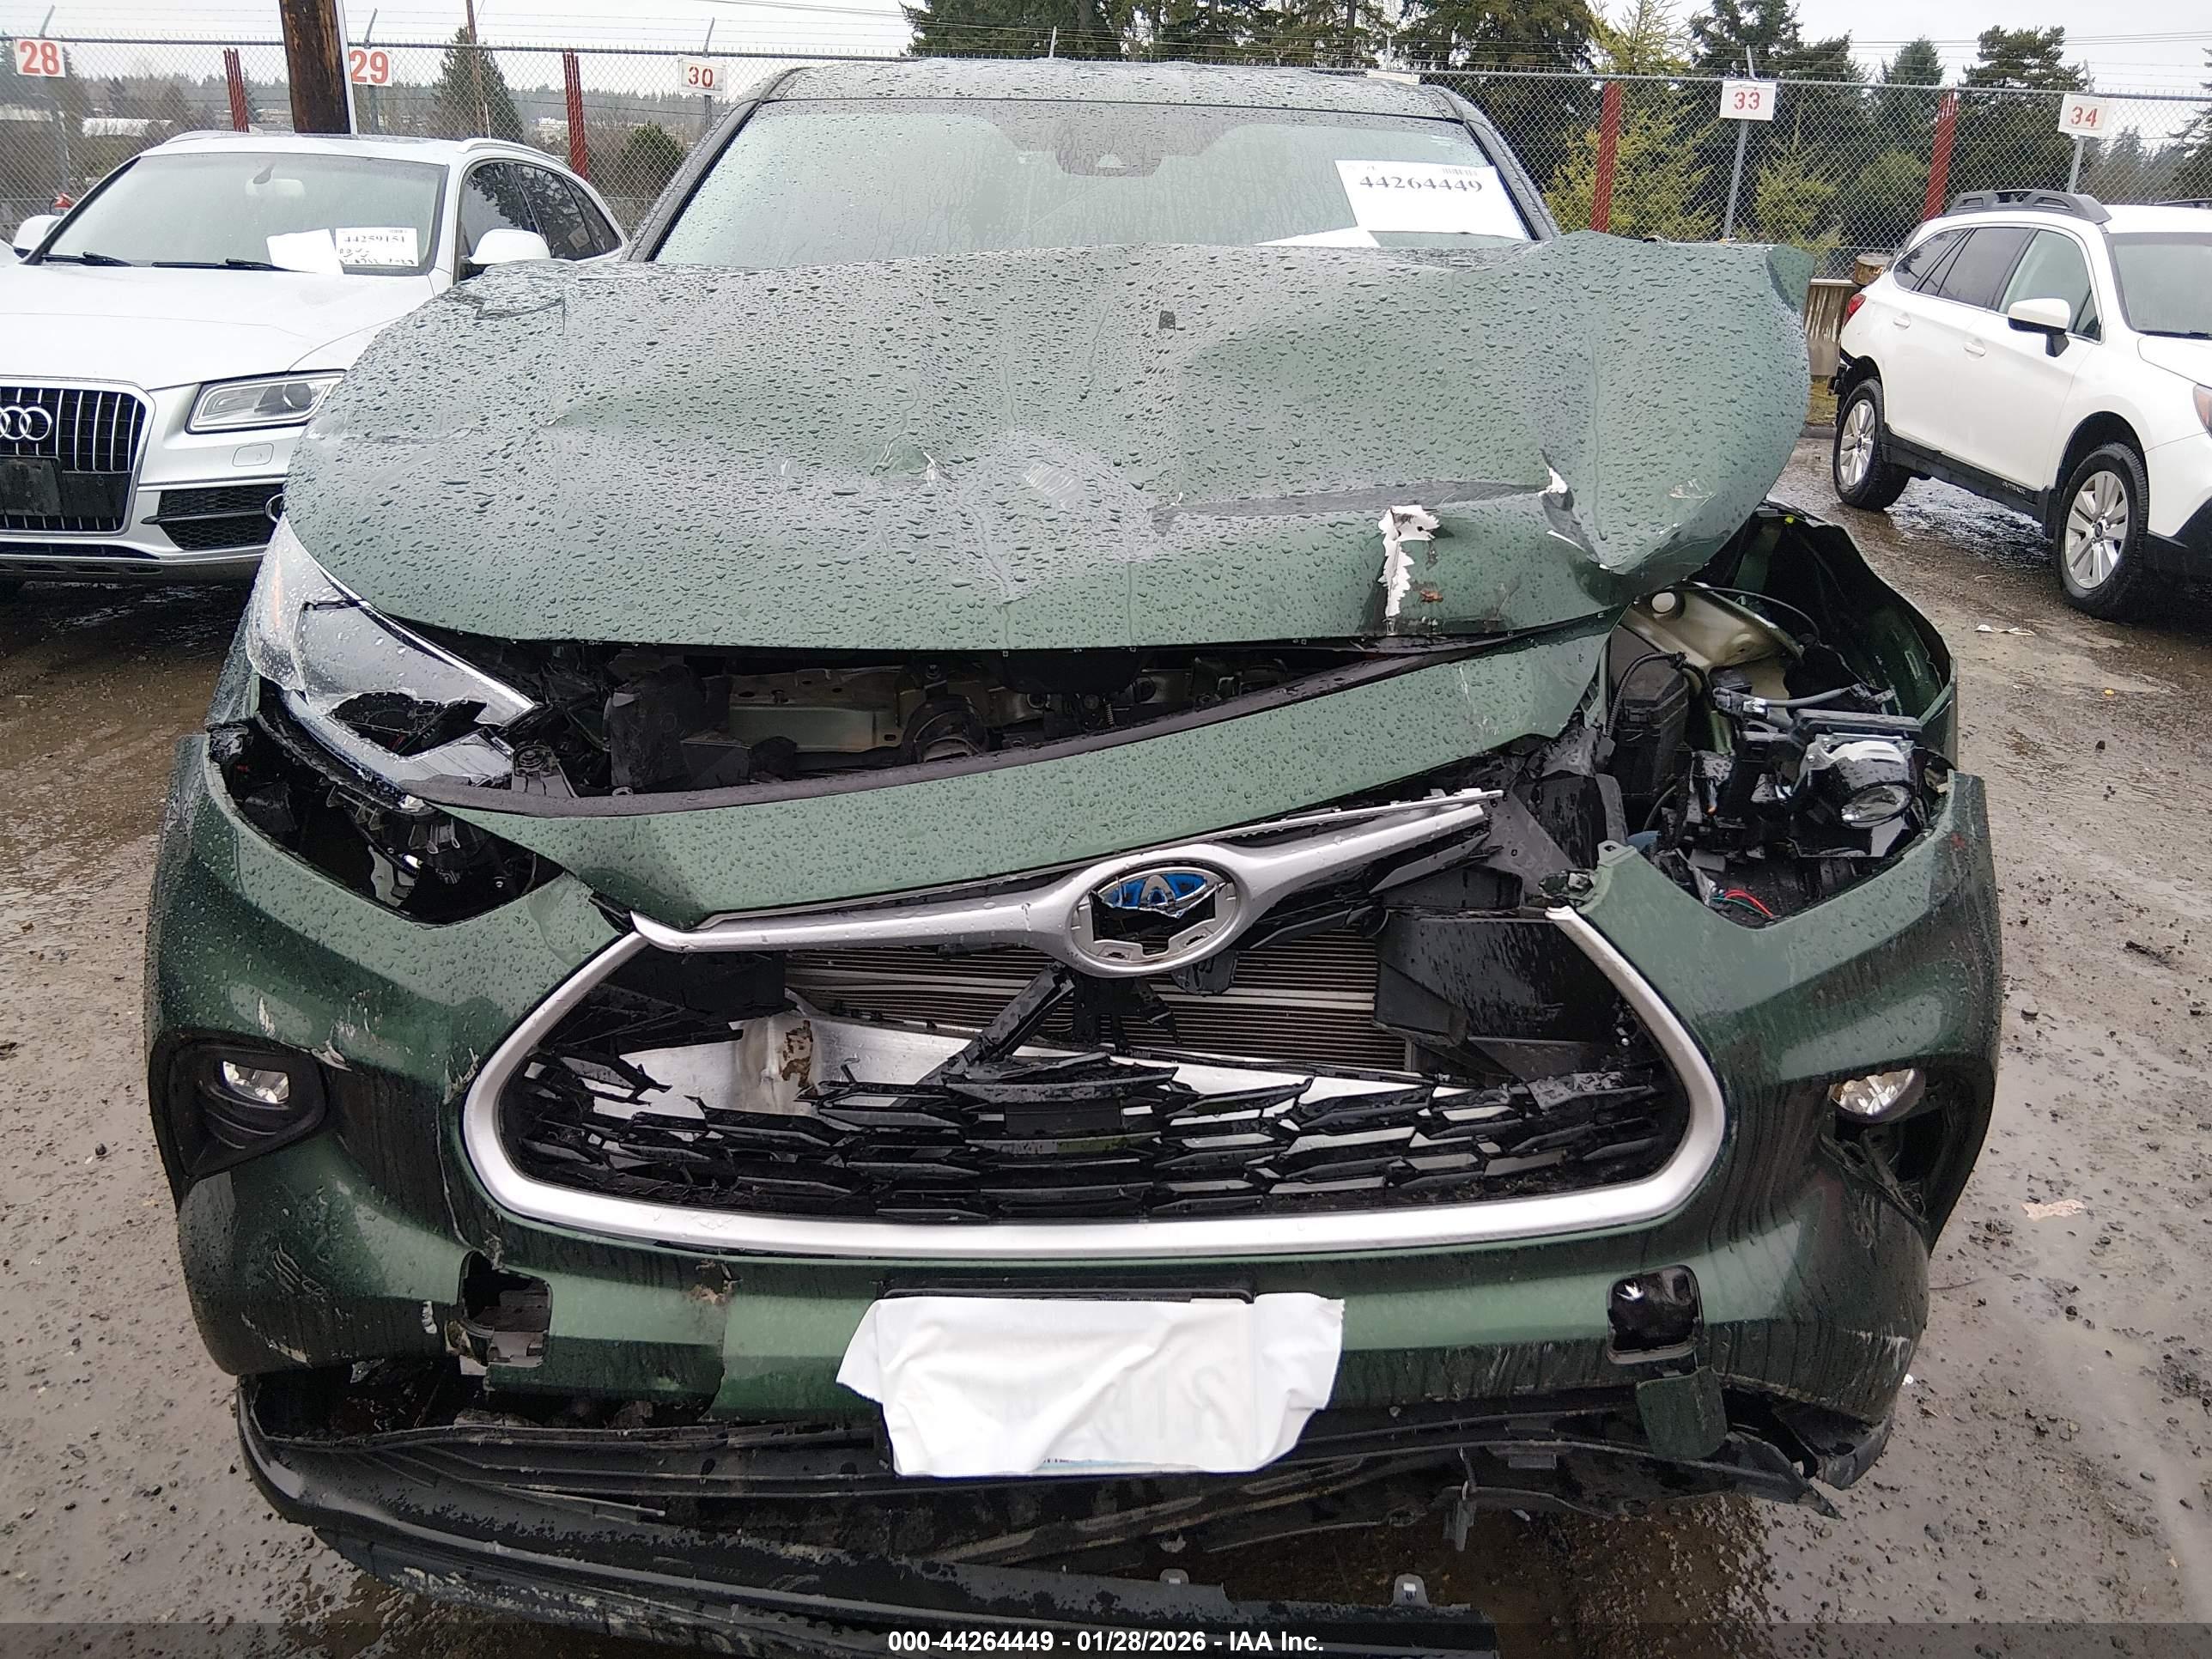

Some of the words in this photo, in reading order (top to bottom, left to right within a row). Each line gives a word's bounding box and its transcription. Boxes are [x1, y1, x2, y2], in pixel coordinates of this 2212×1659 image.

[20, 40, 60, 76] 28
[349, 50, 389, 84] 29
[688, 66, 714, 88] 30
[1734, 91, 1760, 110] 33
[2070, 106, 2098, 127] 34
[1359, 175, 1483, 192] 44264449
